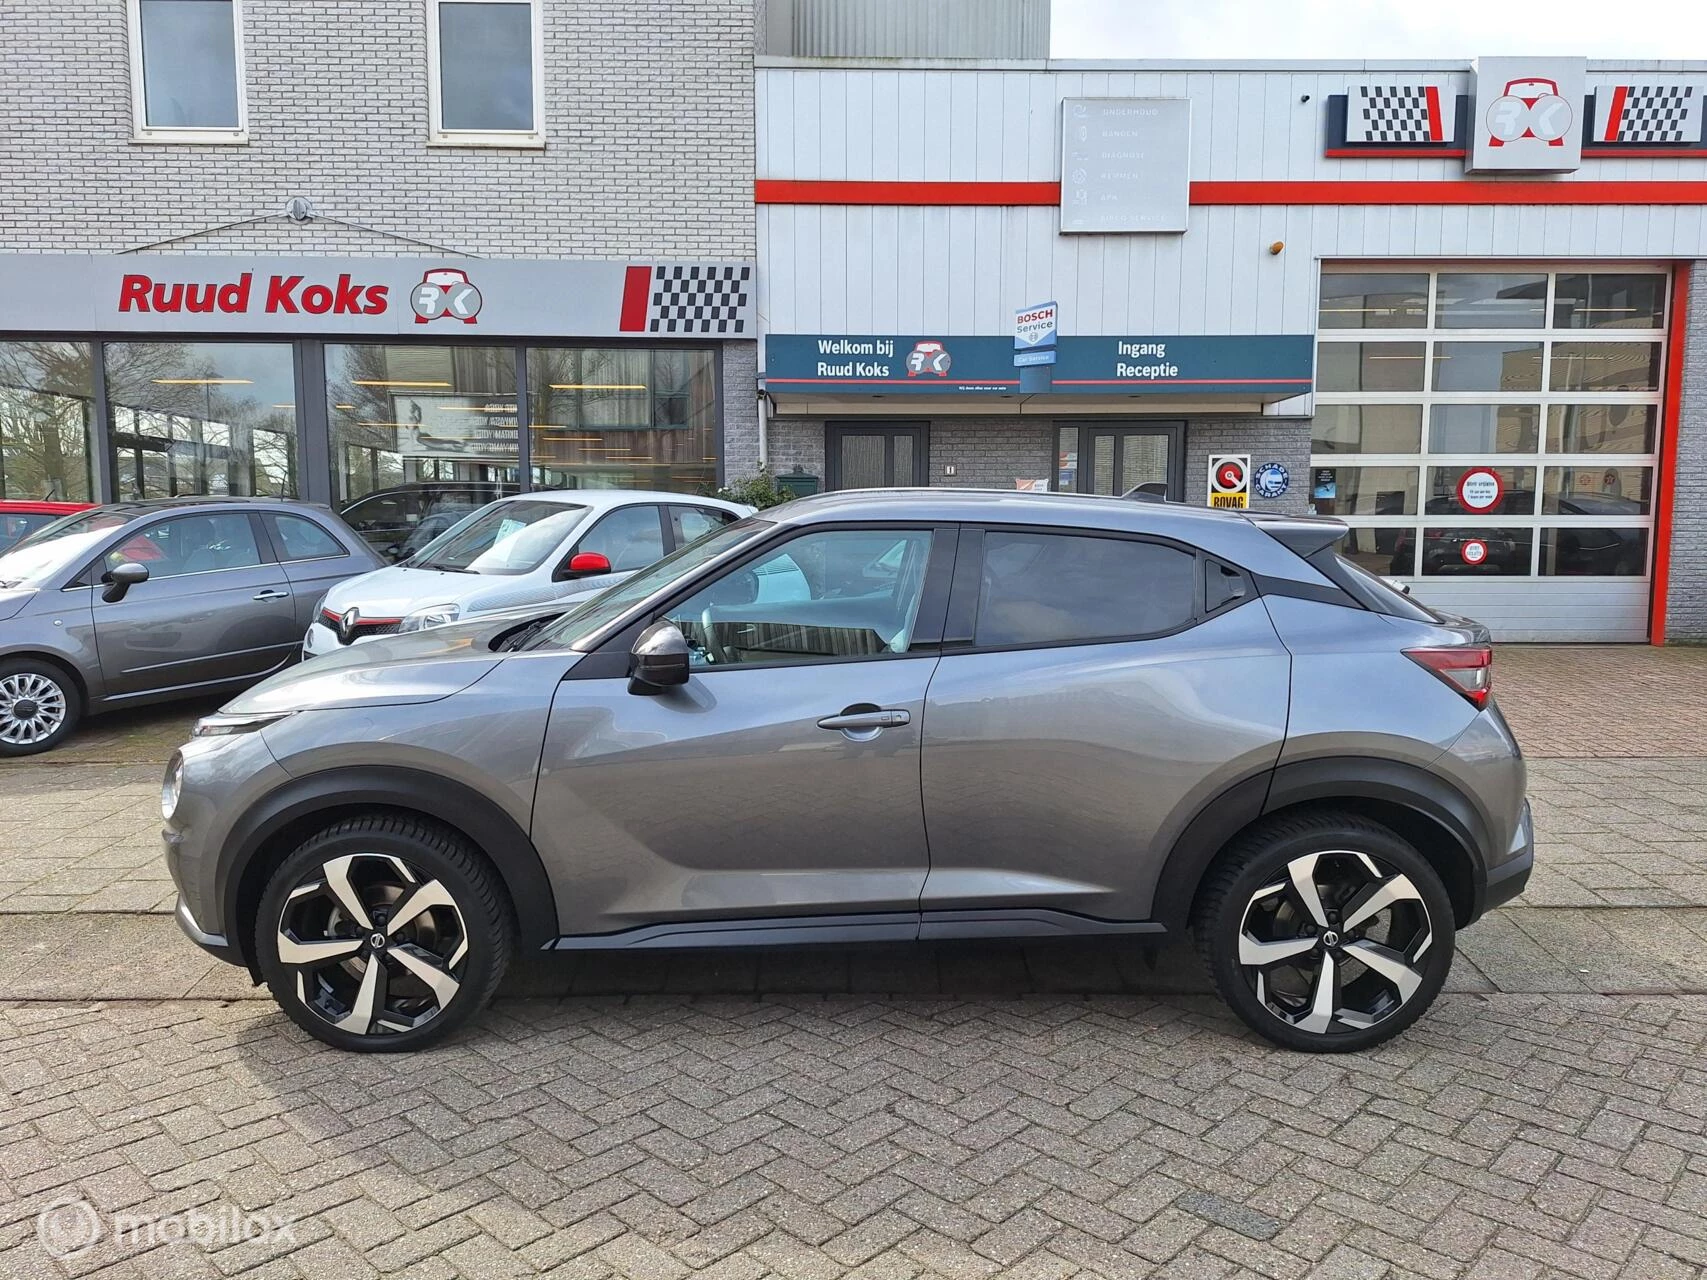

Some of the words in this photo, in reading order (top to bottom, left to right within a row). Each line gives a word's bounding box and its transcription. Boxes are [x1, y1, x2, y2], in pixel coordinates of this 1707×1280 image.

[118, 272, 252, 313] Ruud
[264, 273, 389, 315] Koks
[1017, 309, 1053, 324] BOSCH
[1016, 322, 1053, 334] Service
[818, 340, 873, 354] Welkom
[876, 340, 894, 358] bij
[1118, 341, 1166, 358] Ingang
[817, 362, 853, 377] Ruud
[856, 362, 889, 377] Koks
[1116, 362, 1178, 380] Receptie
[1213, 496, 1244, 509] BOVAG
